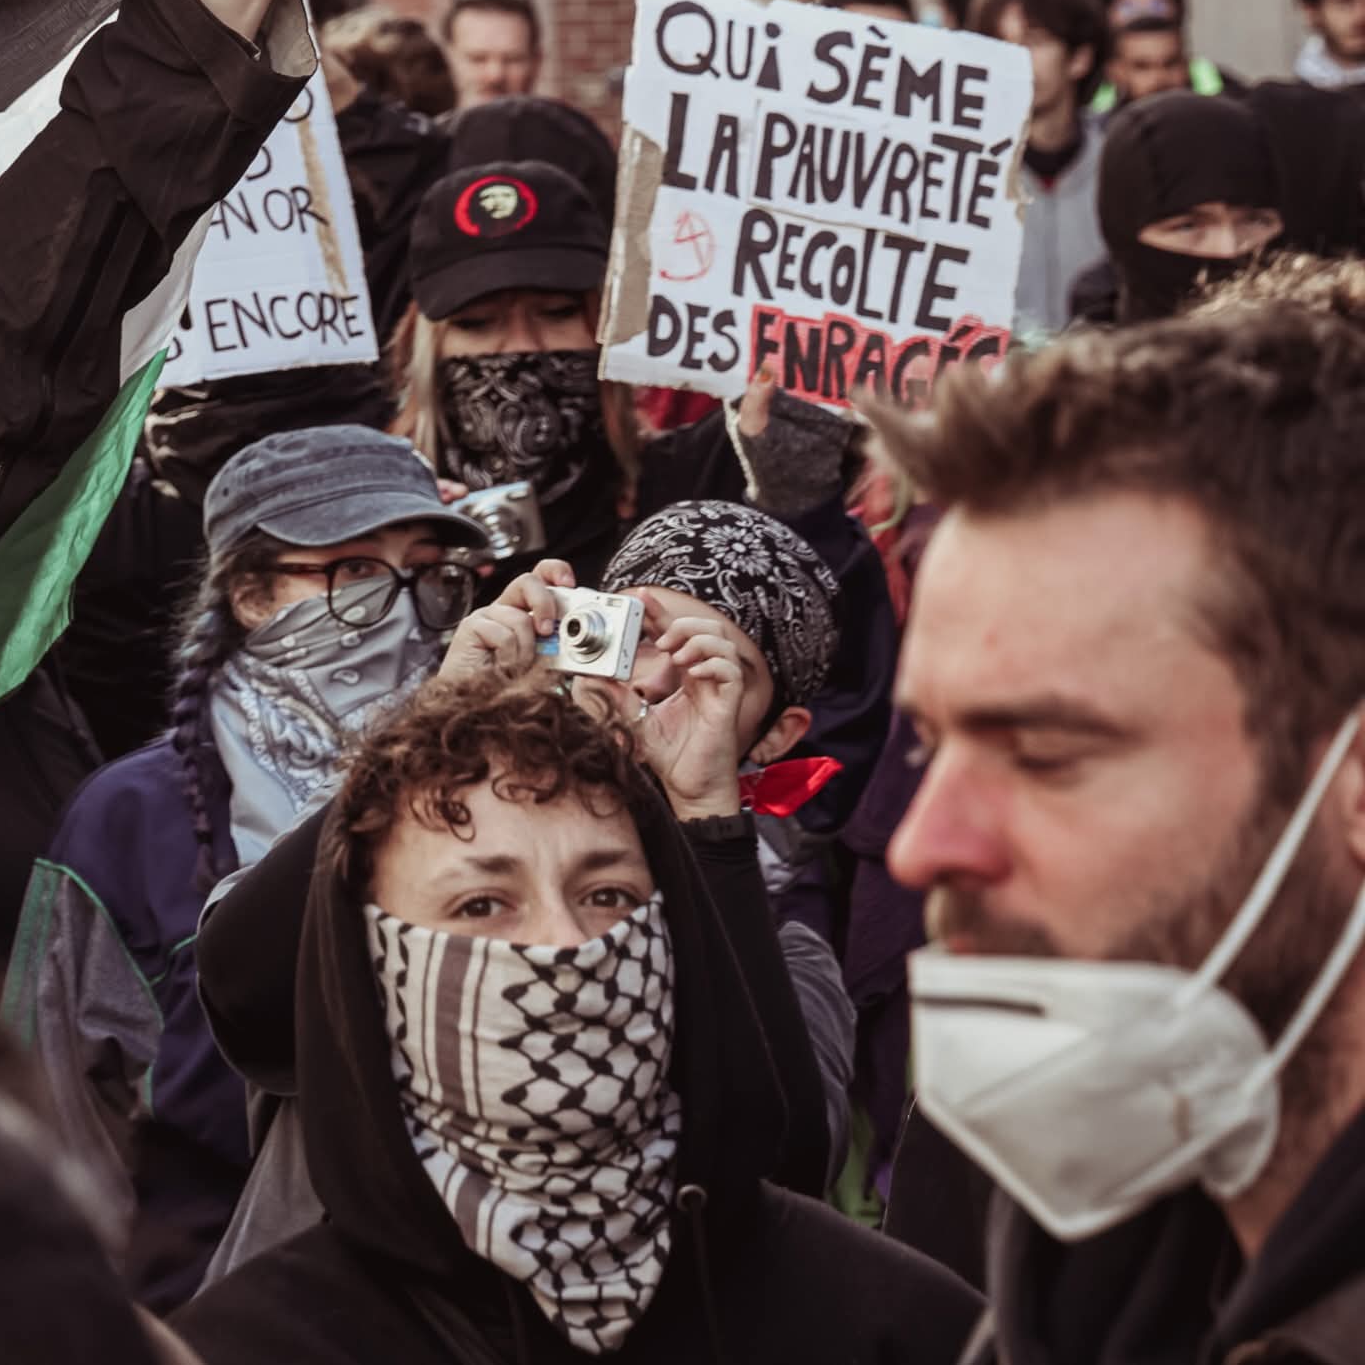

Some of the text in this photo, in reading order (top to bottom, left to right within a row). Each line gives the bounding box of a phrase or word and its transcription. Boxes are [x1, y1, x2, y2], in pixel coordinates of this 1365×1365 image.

[806, 24, 990, 130] SÈME
[663, 91, 1013, 229] LA PAUVRETÉ
[205, 291, 365, 354] ENCORE
[732, 208, 971, 331] RECOLTE
[646, 294, 741, 372] DES
